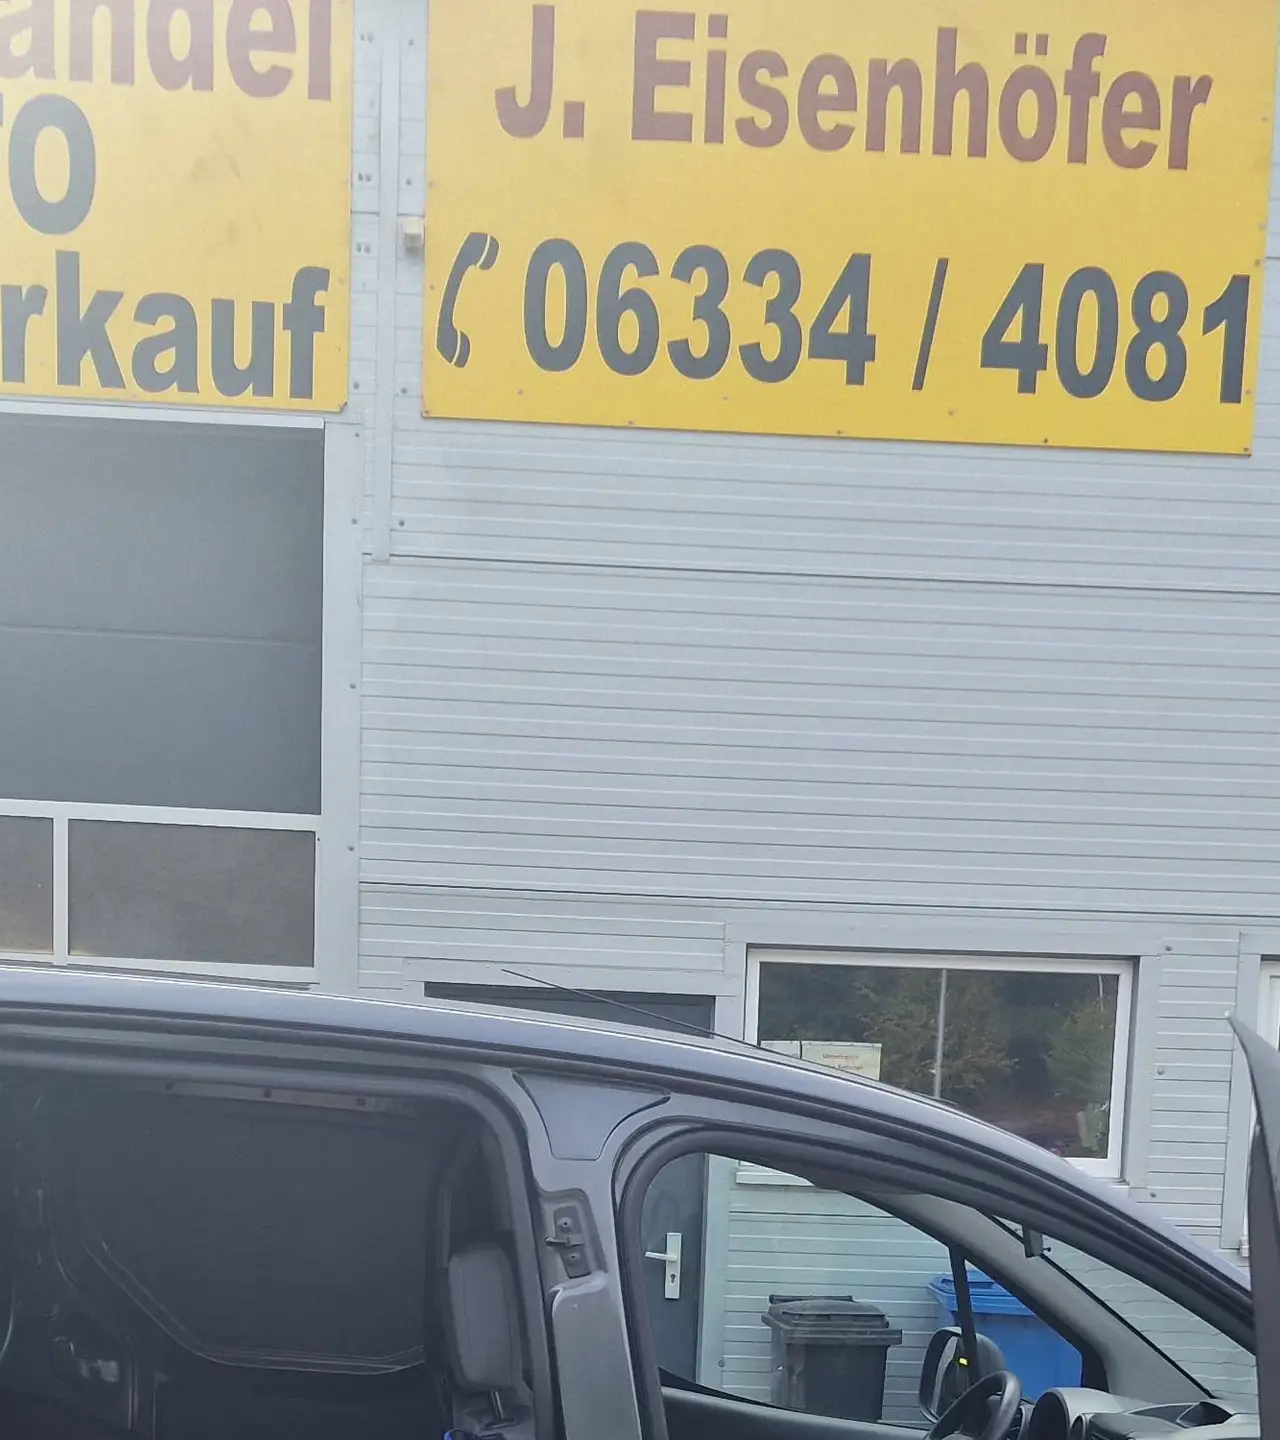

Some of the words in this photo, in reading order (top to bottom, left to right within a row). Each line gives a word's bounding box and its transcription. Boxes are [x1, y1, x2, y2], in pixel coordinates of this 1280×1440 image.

[494, 5, 585, 140] J.
[630, 11, 1214, 171] Eisenhöfer
[522, 237, 877, 386] 06334
[911, 257, 950, 391] /
[979, 262, 1252, 404] 4081
